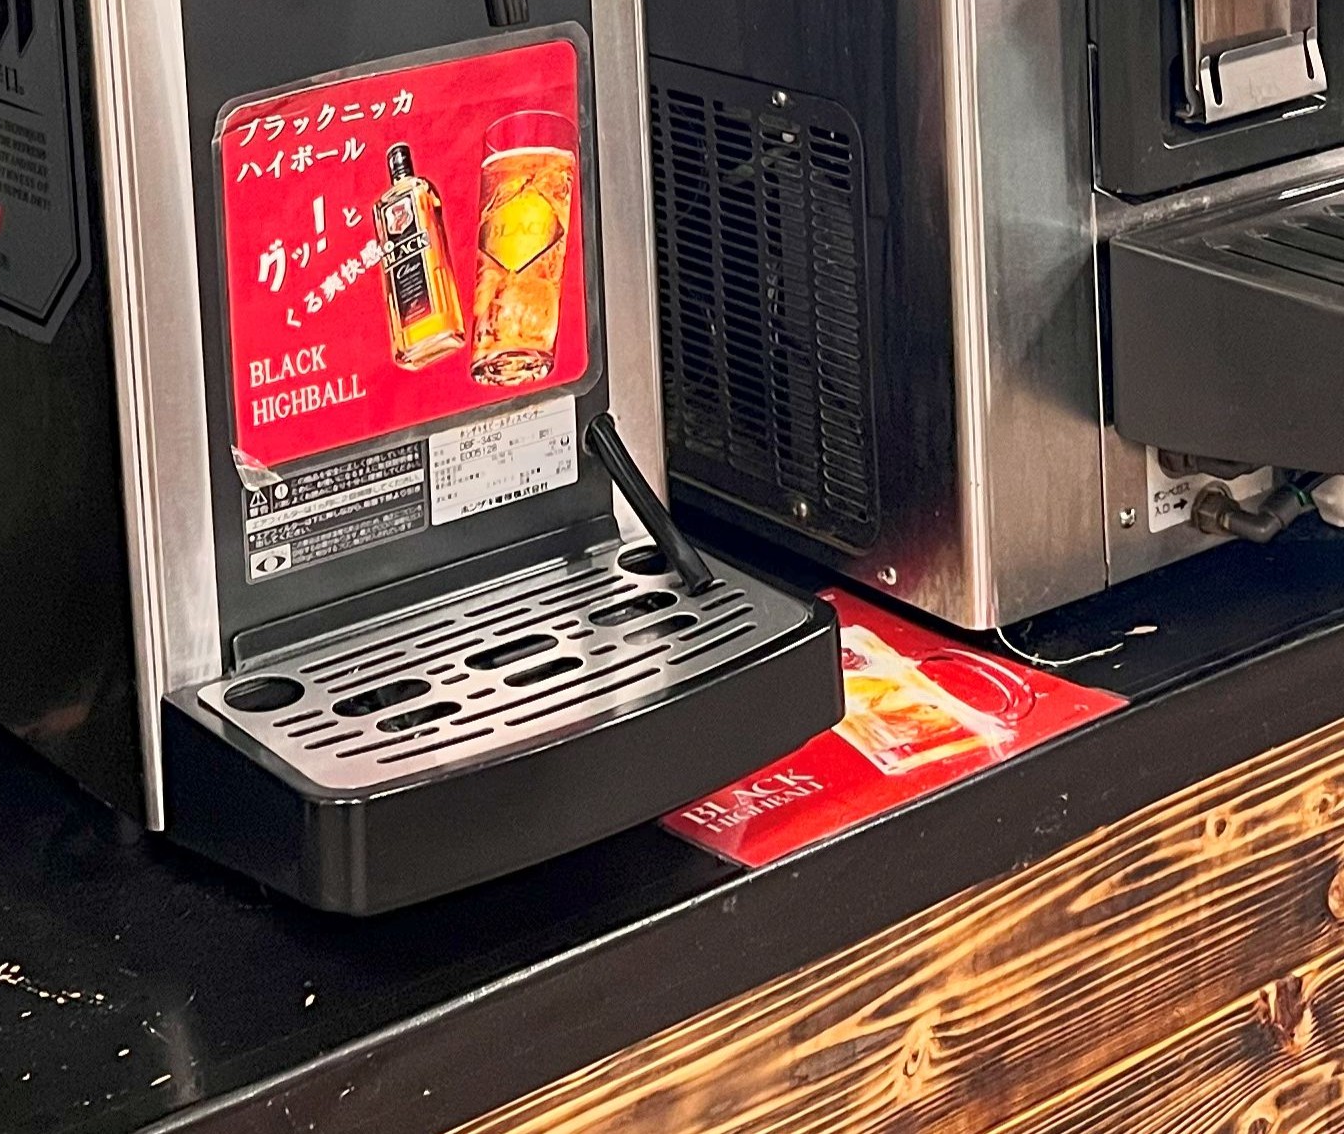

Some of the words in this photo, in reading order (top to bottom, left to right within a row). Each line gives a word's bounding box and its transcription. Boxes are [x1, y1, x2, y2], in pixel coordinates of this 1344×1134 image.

[236, 88, 415, 149] ブラックニッカ
[235, 135, 367, 184] ハイボール
[384, 233, 430, 269] BLACK
[249, 345, 328, 389] BLACK
[252, 375, 367, 426] HIGHBALL
[682, 768, 816, 827] BLACK
